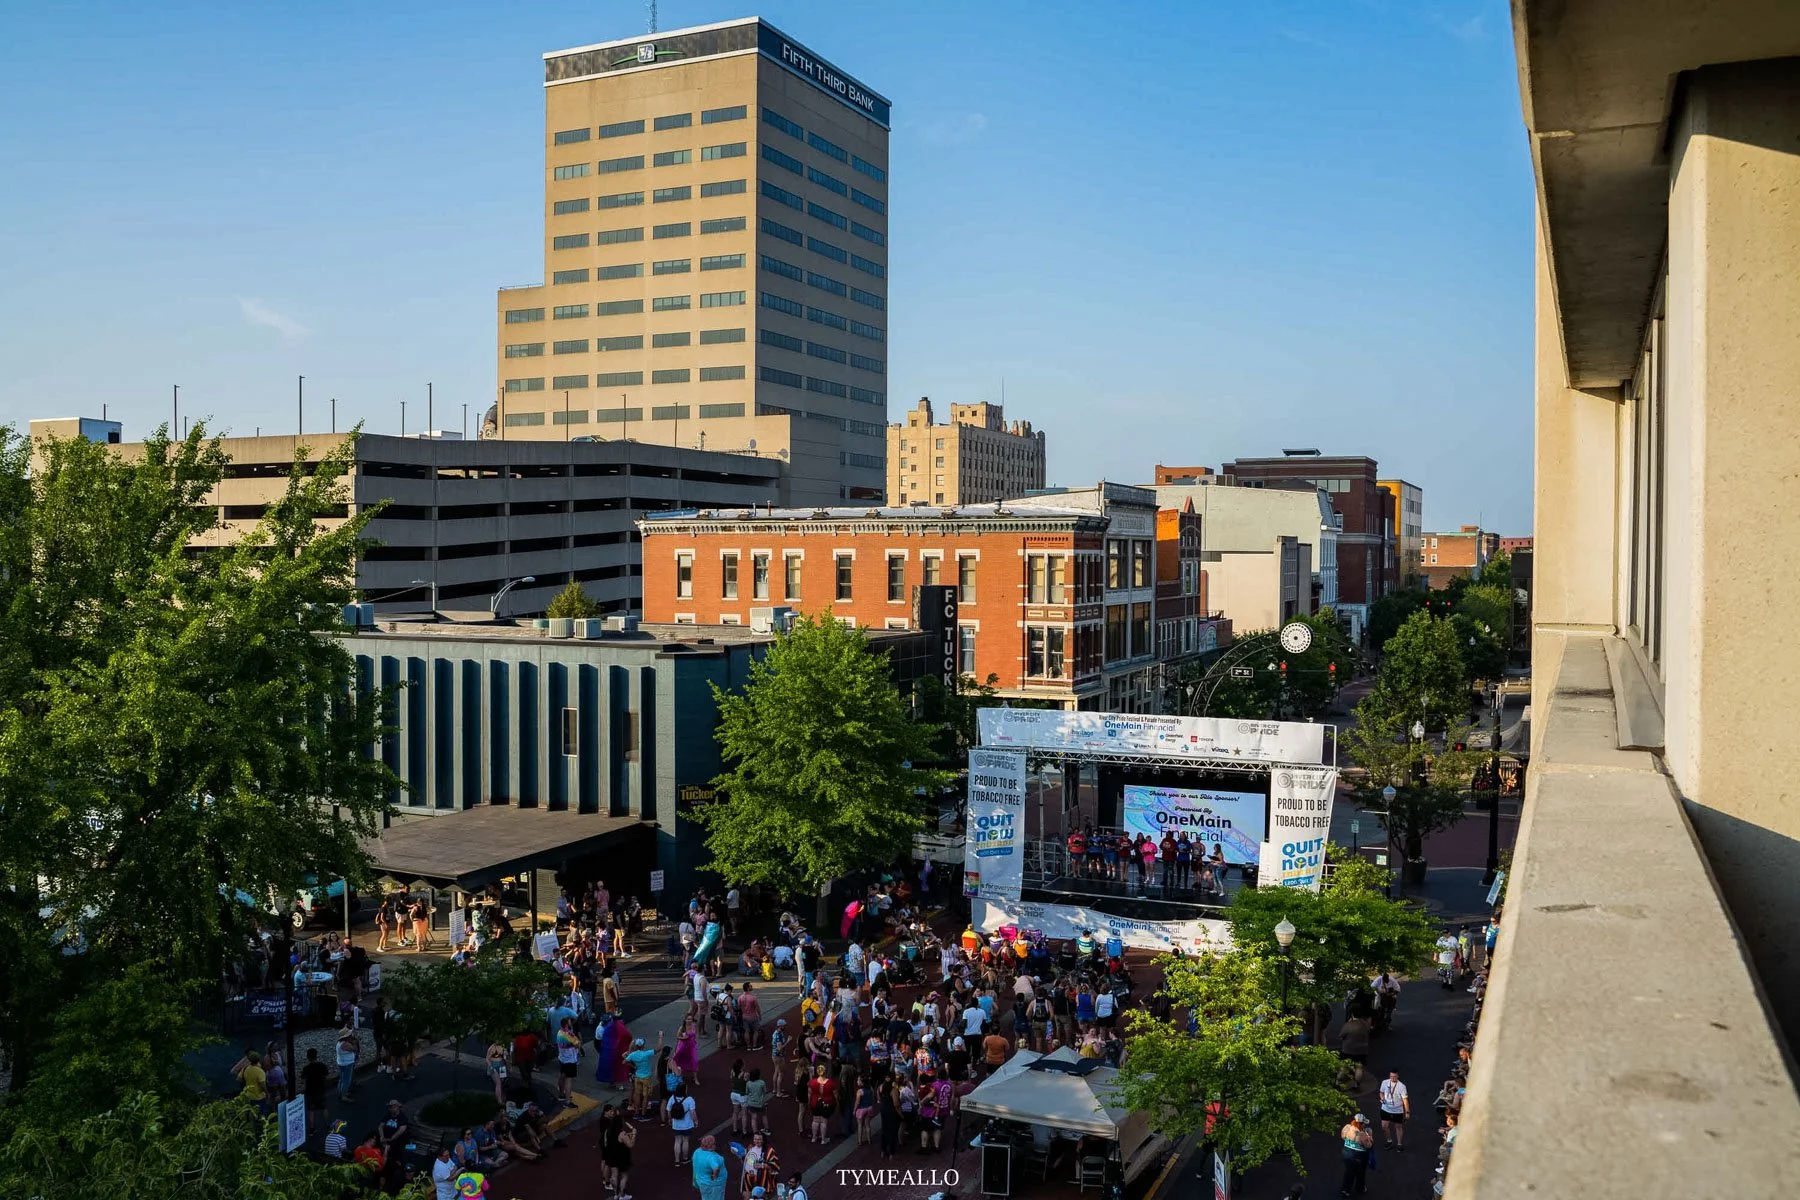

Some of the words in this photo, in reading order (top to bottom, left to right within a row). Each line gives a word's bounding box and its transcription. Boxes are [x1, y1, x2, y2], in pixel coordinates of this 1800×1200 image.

[782, 43, 813, 75] FIFTH
[815, 63, 847, 95] THIRD
[848, 85, 874, 112] BANK
[944, 589, 955, 619] FC
[943, 626, 954, 696] TUCK
[1104, 720, 1142, 730] OneMain
[986, 760, 1017, 771] PRIDE
[974, 774, 998, 787] PROUD
[999, 777, 1008, 789] TO
[1009, 778, 1018, 790] BE
[680, 789, 714, 800] Tucker
[972, 790, 1003, 804] TOBACCO
[1004, 794, 1021, 806] FREE
[1277, 797, 1303, 811] PROUD
[1304, 799, 1315, 811] TO
[1317, 799, 1327, 811] BE
[977, 813, 1015, 830] QUIT
[1156, 811, 1232, 829] OneMain
[1275, 814, 1310, 828] TOBACCO
[1282, 837, 1324, 858] QUIT
[1109, 919, 1147, 931] OneMain
